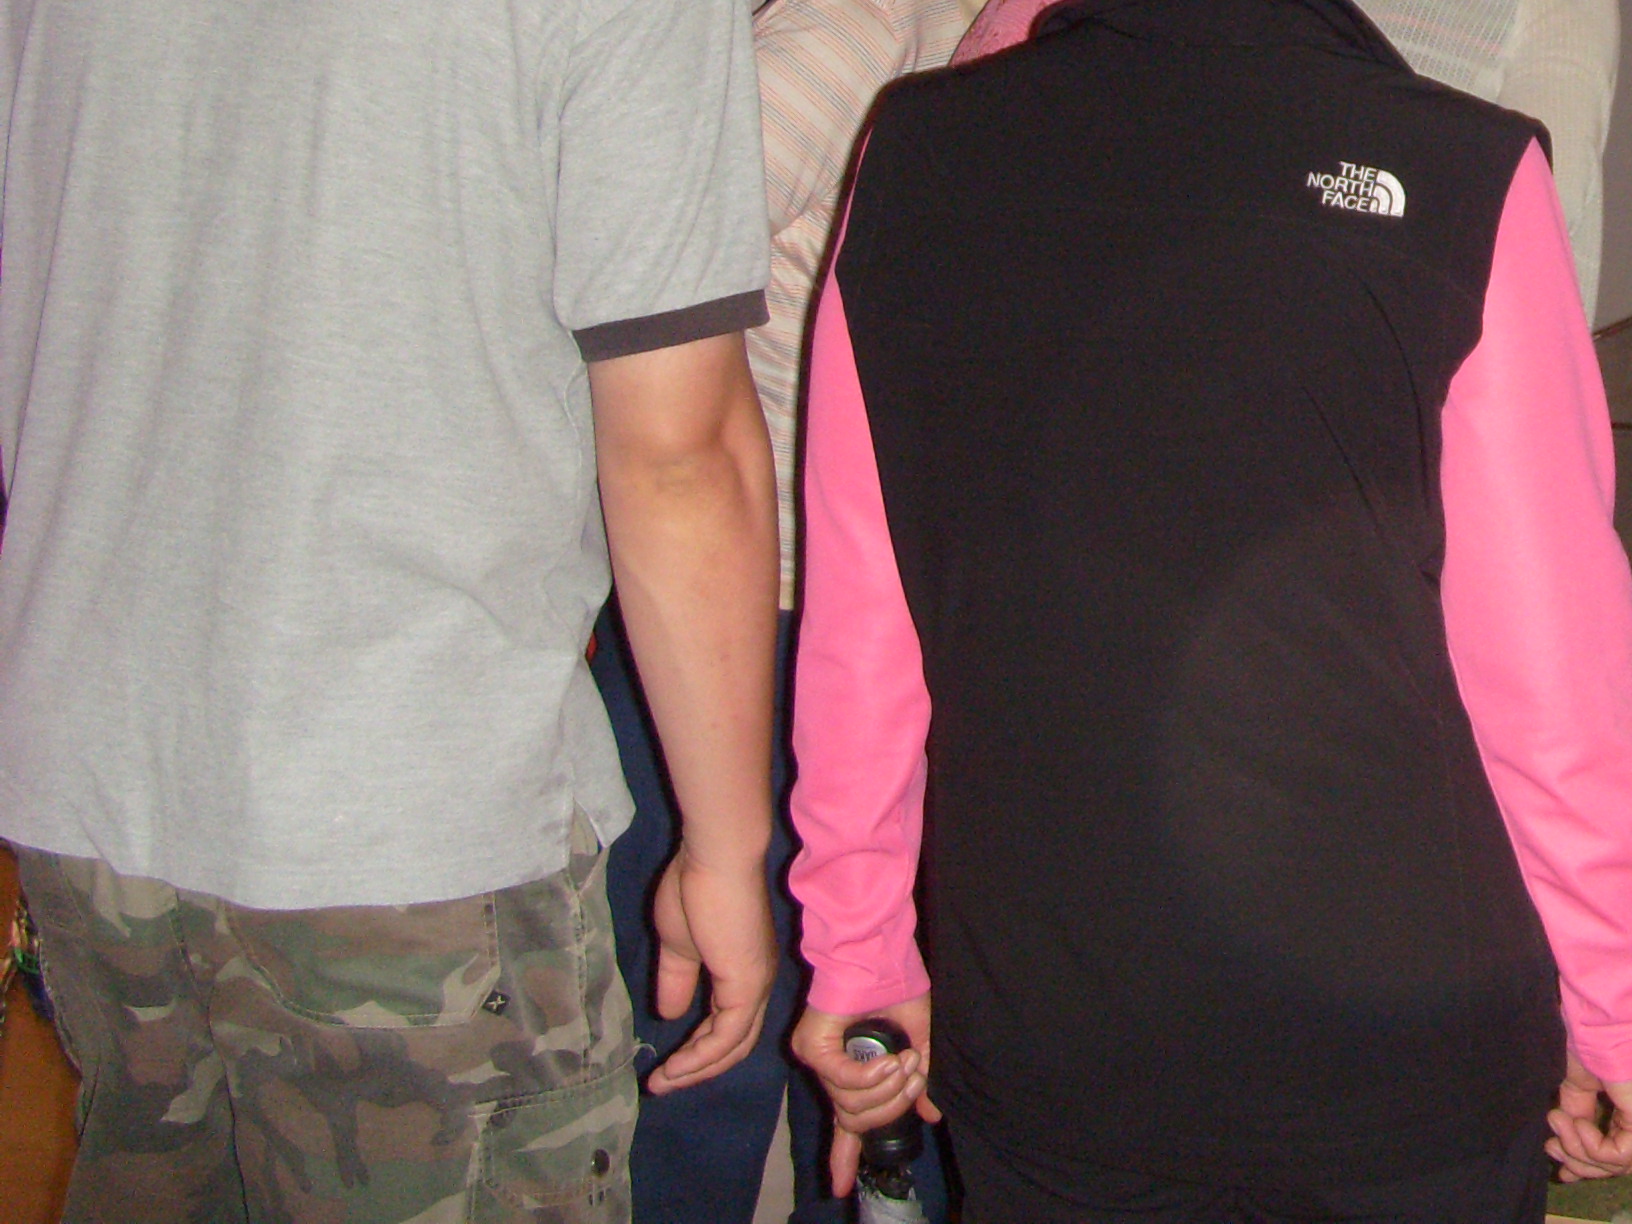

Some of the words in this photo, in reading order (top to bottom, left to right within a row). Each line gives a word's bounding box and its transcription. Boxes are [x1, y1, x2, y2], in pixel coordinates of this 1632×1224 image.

[1339, 161, 1377, 182] THE
[1306, 171, 1375, 197] NORTH
[1322, 191, 1370, 213] FACE
